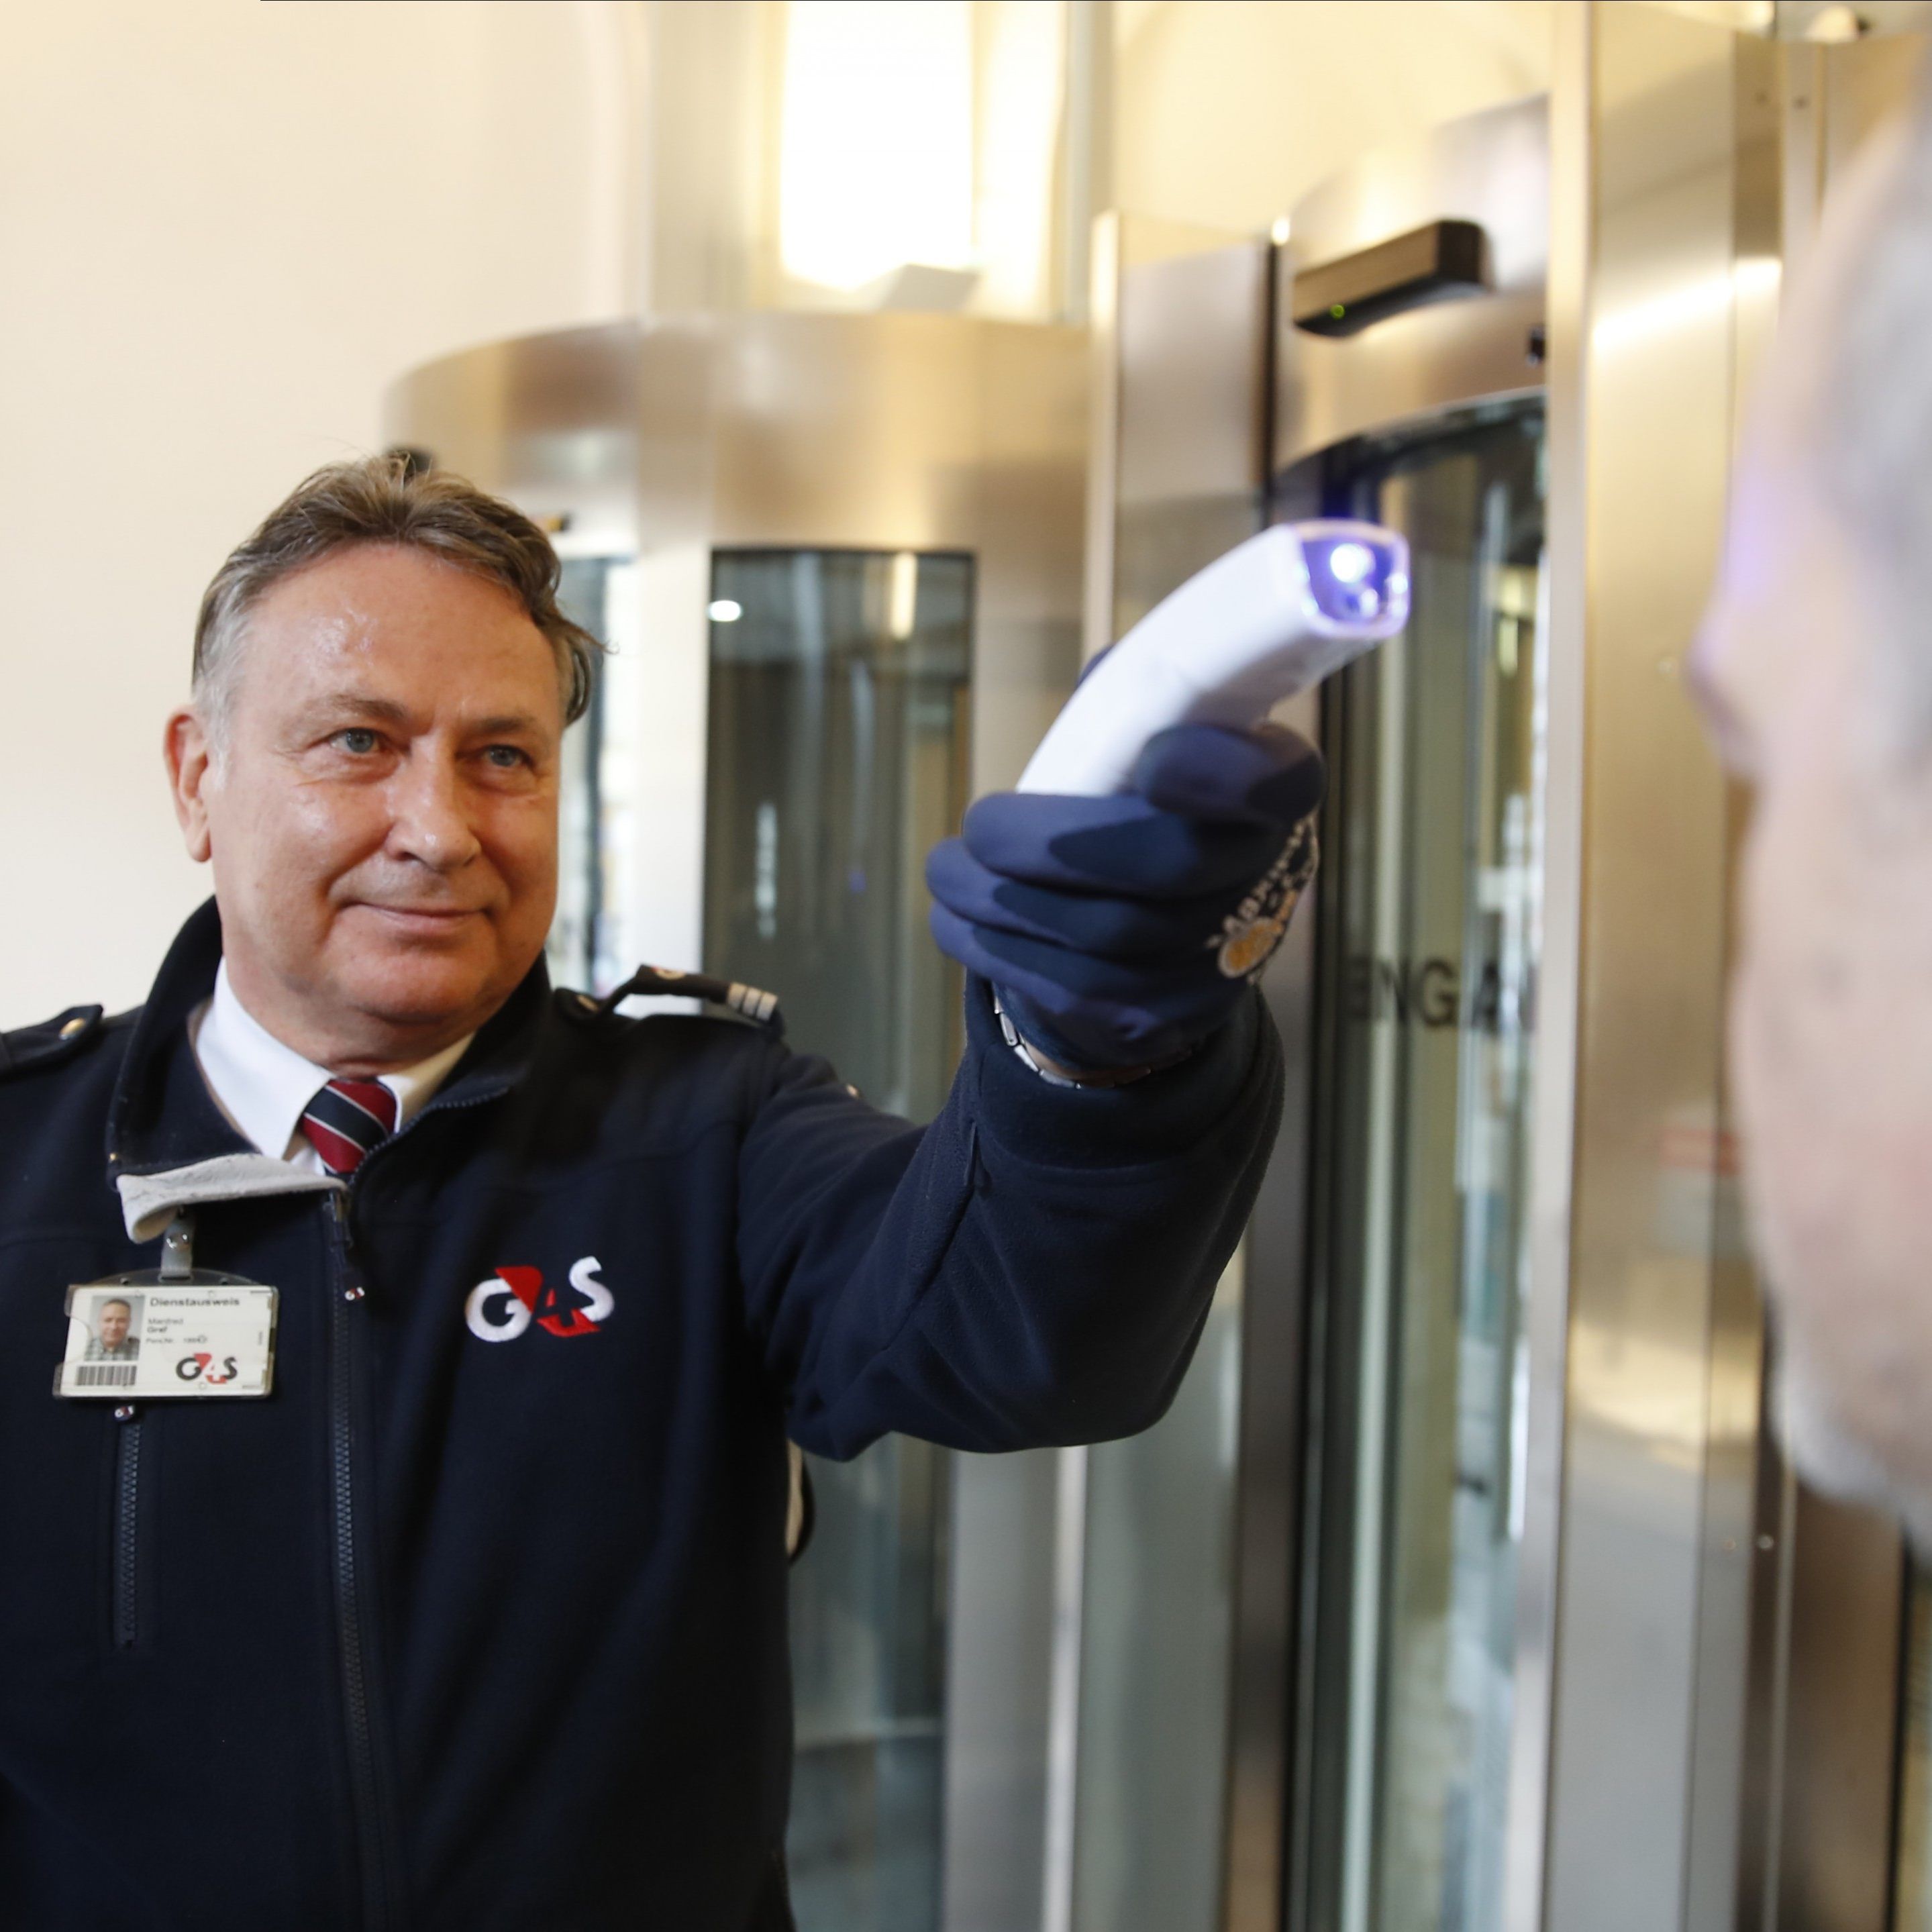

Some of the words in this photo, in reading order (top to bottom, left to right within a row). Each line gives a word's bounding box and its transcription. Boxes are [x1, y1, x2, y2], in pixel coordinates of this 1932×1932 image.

[150, 1297, 240, 1307] Dienstausweis
[464, 1256, 615, 1342] G4S
[176, 1352, 238, 1385] G4S
